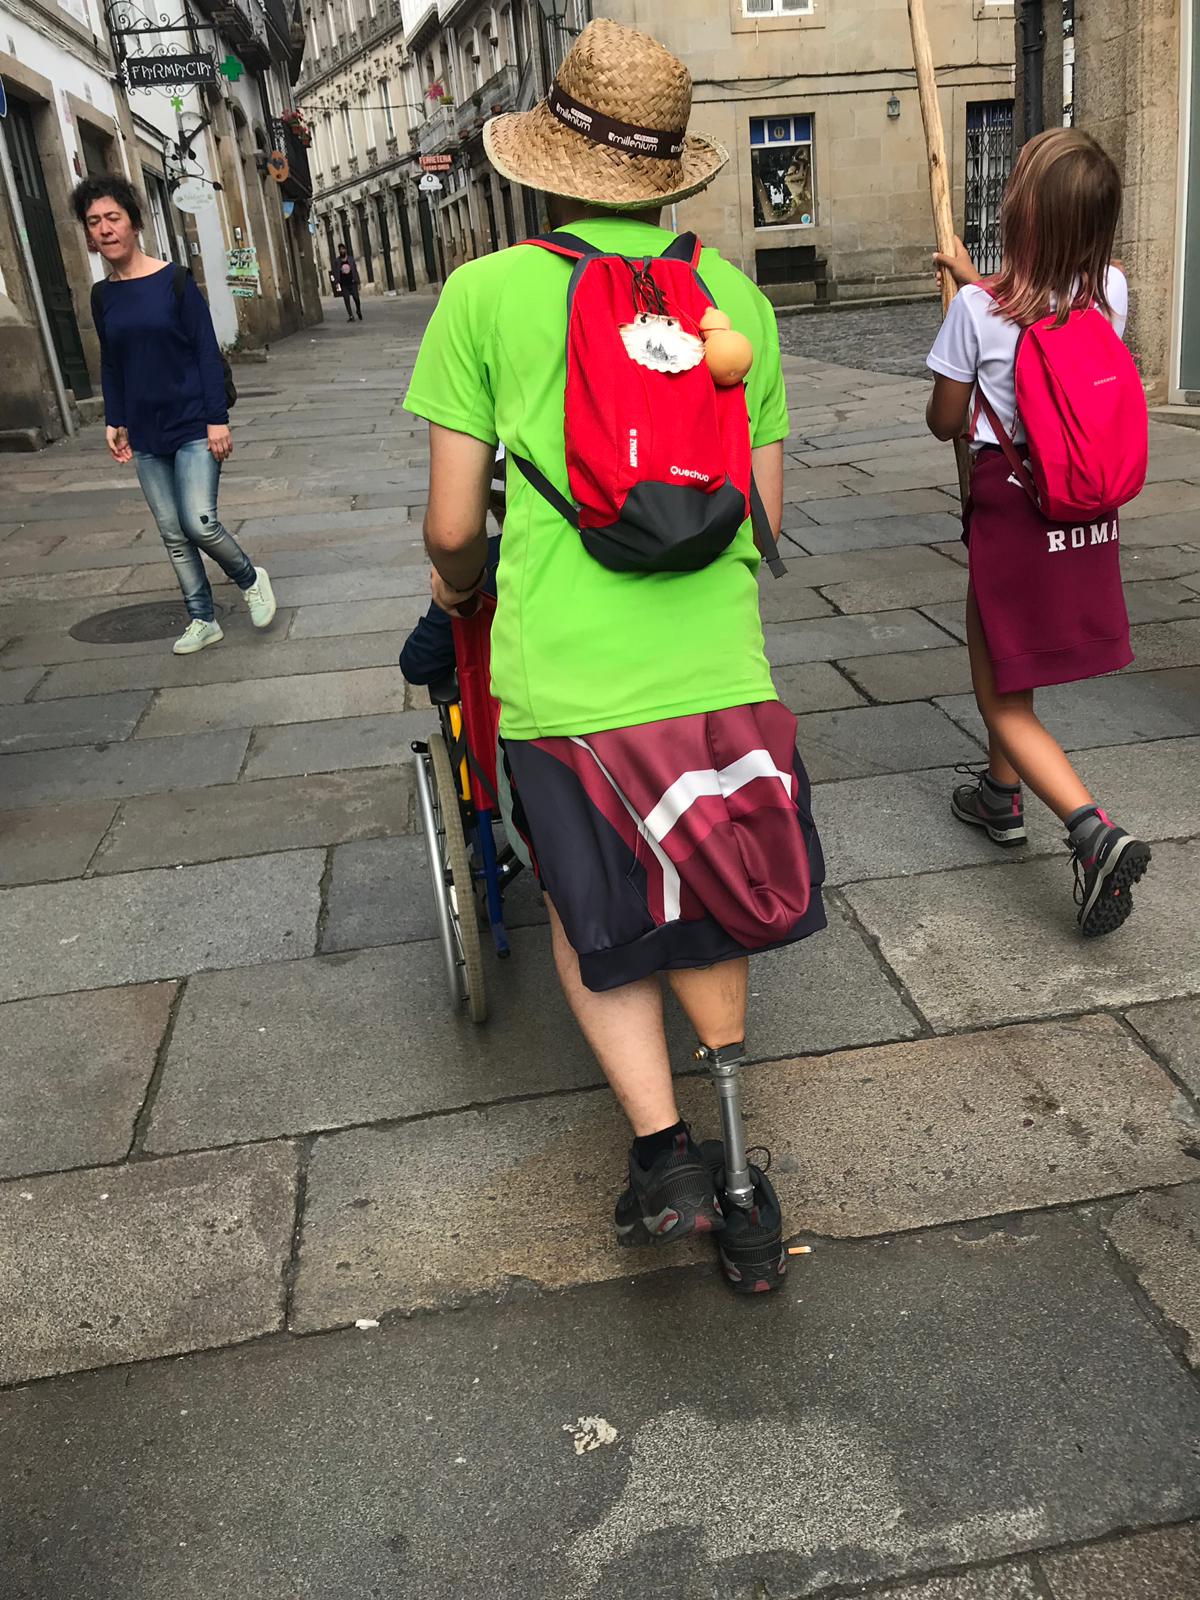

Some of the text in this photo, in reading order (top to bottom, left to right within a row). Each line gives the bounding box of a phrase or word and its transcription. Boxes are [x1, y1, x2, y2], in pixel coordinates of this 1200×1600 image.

[131, 62, 211, 80] FARMACIA
[613, 136, 658, 152] millenium
[670, 465, 710, 482] Quechua
[1046, 519, 1119, 553] ROMA
